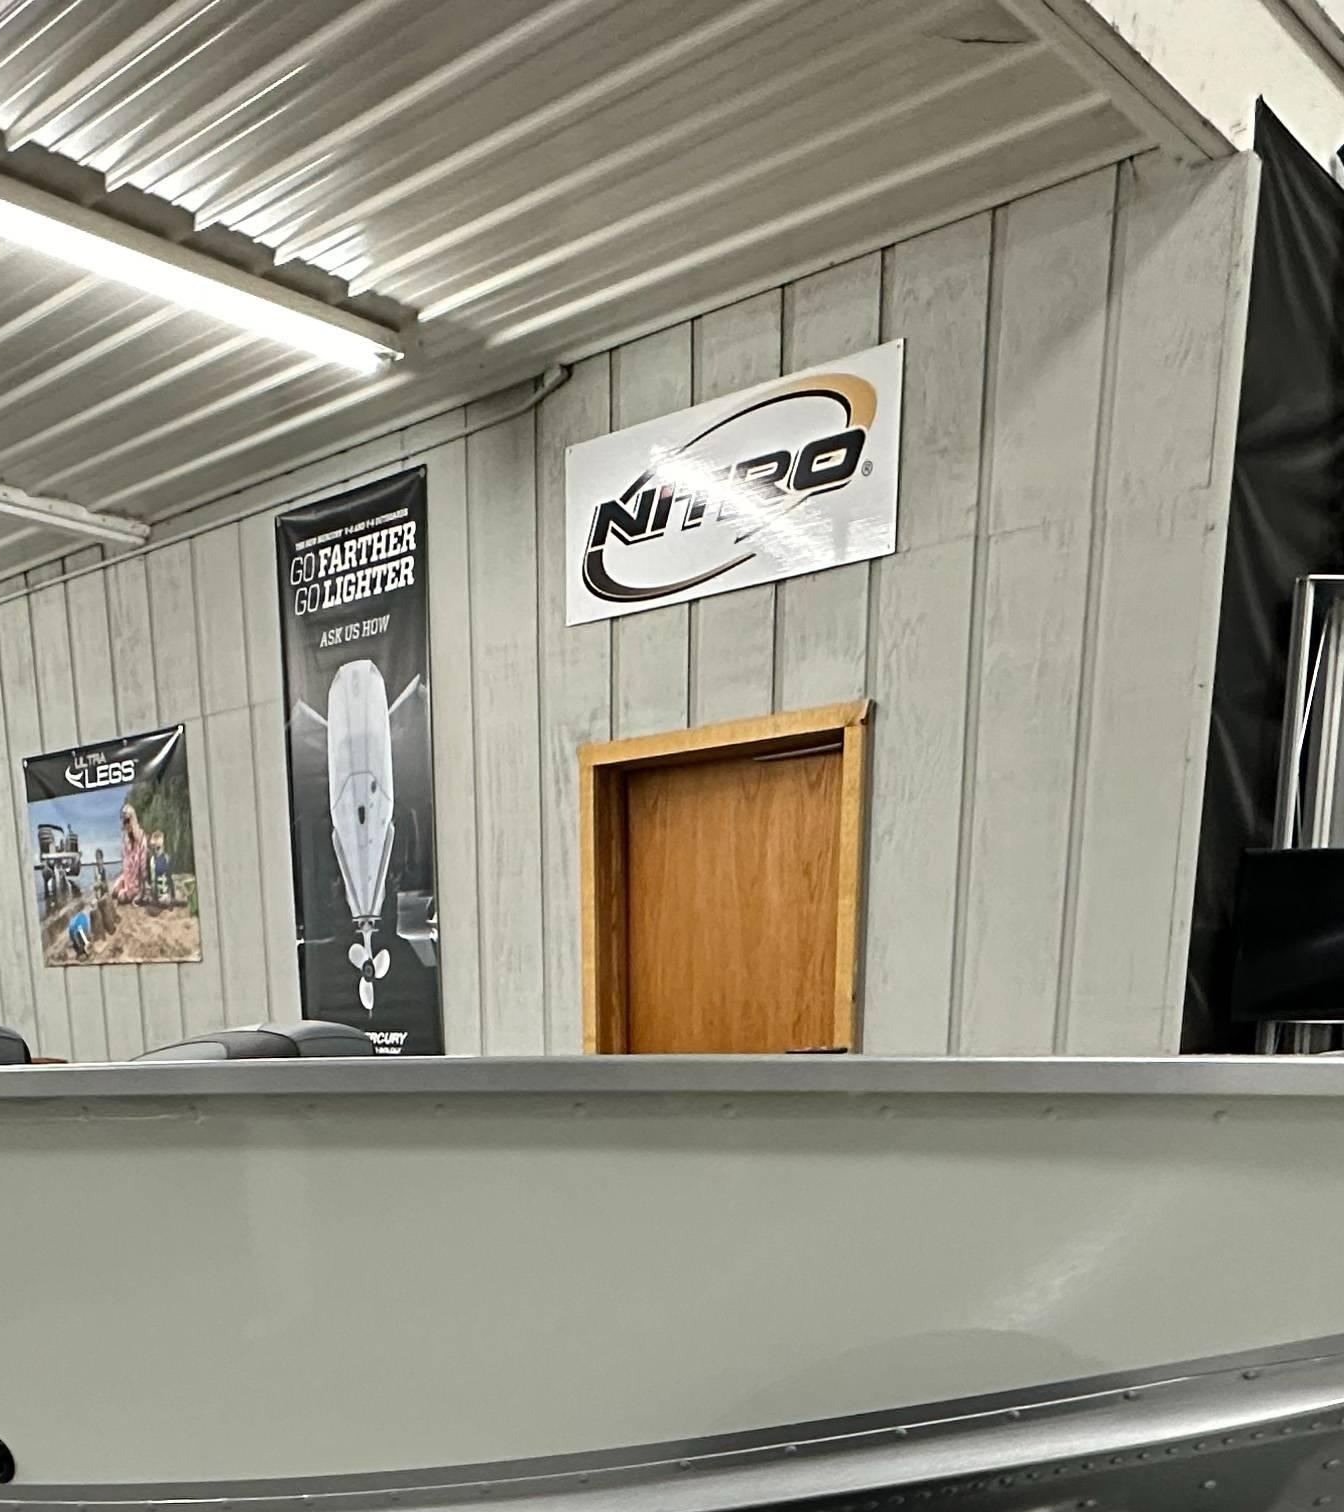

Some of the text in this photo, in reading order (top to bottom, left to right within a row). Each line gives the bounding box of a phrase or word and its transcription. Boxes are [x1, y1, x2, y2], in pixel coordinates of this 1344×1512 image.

[290, 552, 315, 586] GO
[318, 520, 417, 579] FARTHER
[294, 555, 416, 616] GO LIGHTER
[319, 614, 391, 649] ASK US HOW
[74, 752, 107, 769] ULTRA
[84, 759, 135, 789] LEGS
[365, 1031, 408, 1046] RCURY
